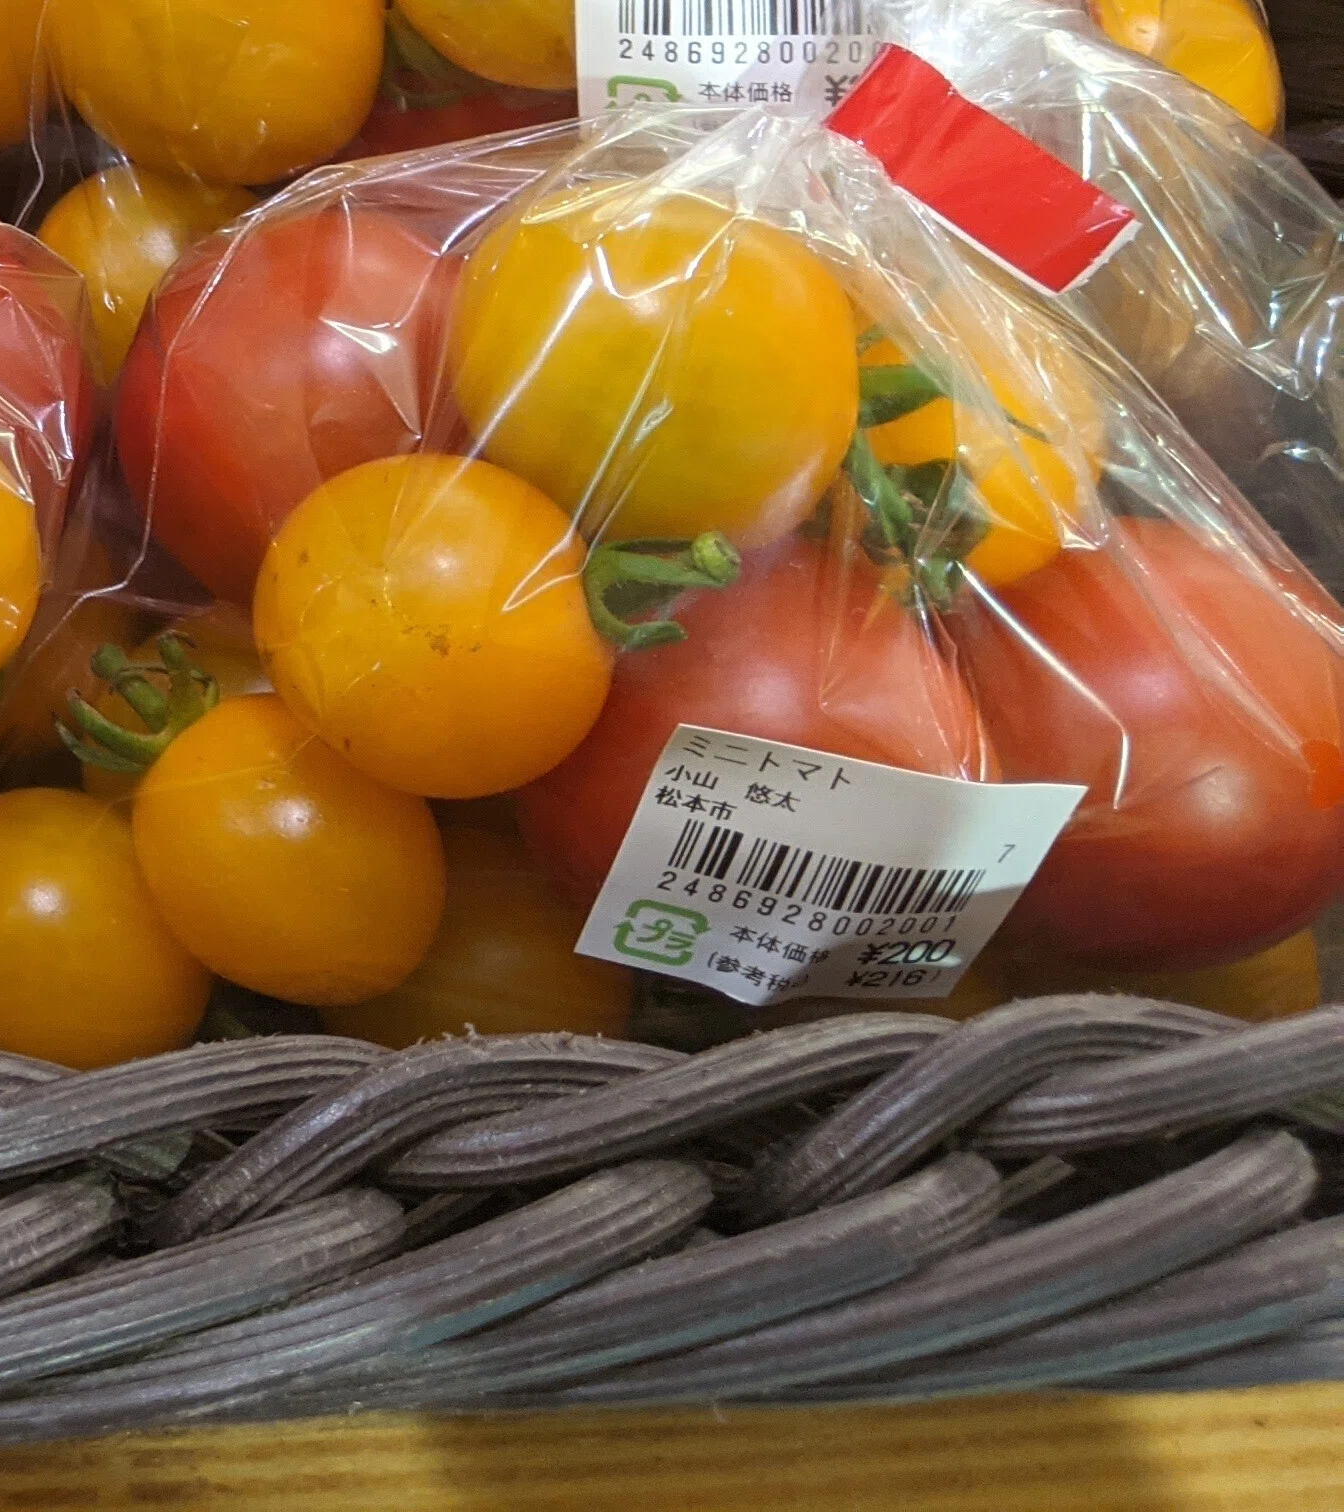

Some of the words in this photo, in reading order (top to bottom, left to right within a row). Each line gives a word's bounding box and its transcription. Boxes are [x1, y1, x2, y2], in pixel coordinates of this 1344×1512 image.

[618, 38, 880, 65] 24869280020
[698, 81, 793, 103] 本体価格
[682, 734, 853, 791] ミニトマト
[653, 785, 739, 822] 松本市
[664, 765, 720, 791] 小山
[744, 780, 802, 814] 悠太
[997, 843, 1017, 864] 7
[657, 870, 958, 937] 2486928002001
[856, 938, 957, 967] ¥200
